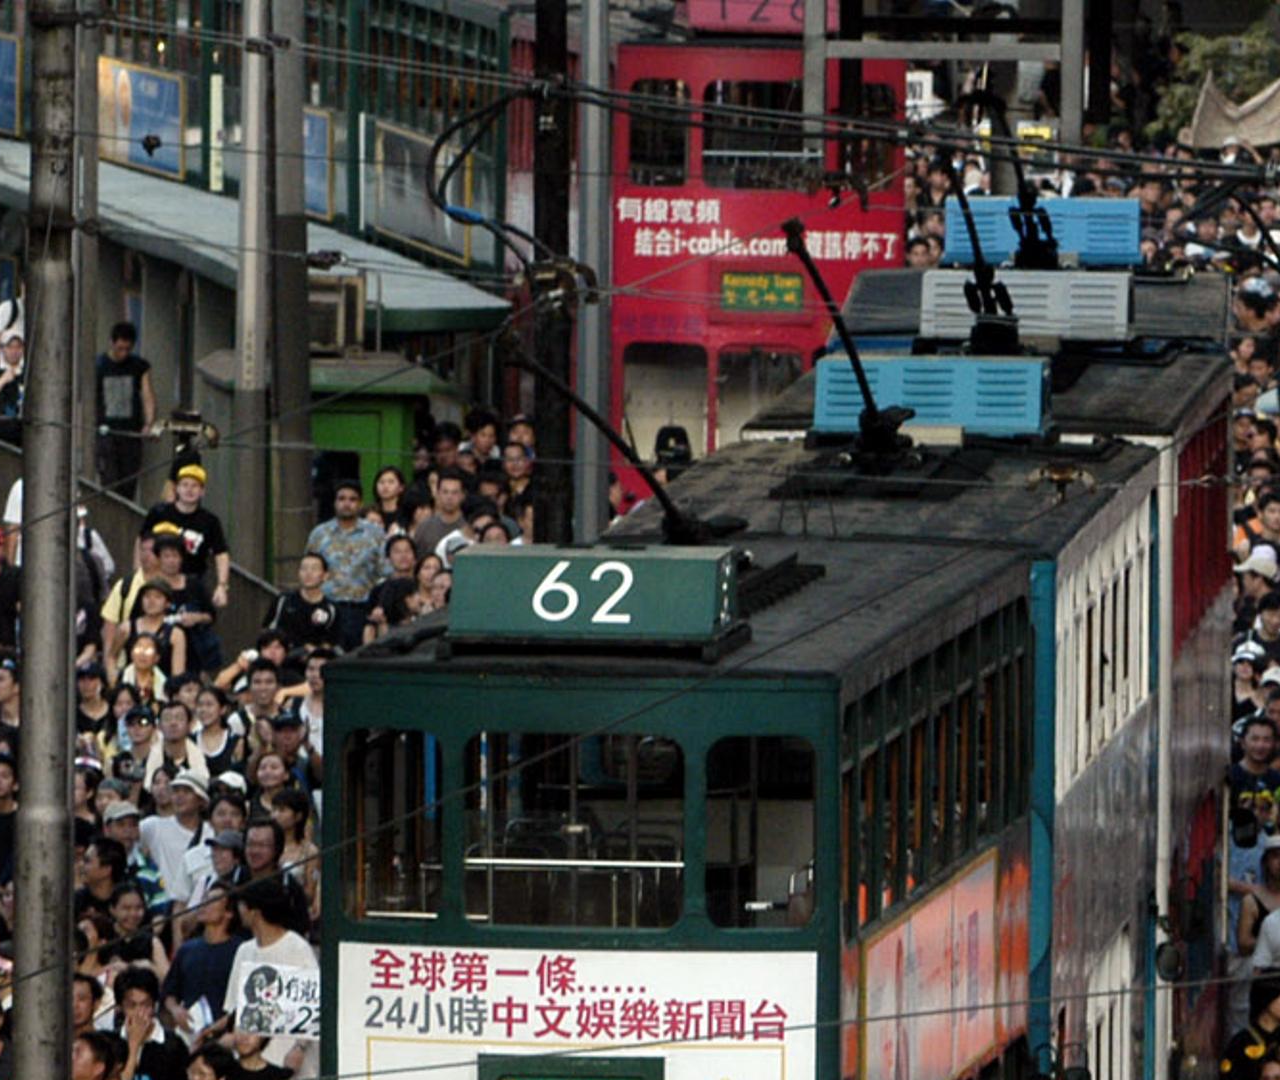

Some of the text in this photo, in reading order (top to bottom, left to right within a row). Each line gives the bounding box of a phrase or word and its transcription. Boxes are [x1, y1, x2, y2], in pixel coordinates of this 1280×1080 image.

[532, 561, 635, 623] 62
[365, 994, 788, 1041] 24小時中文娛樂新聞台
